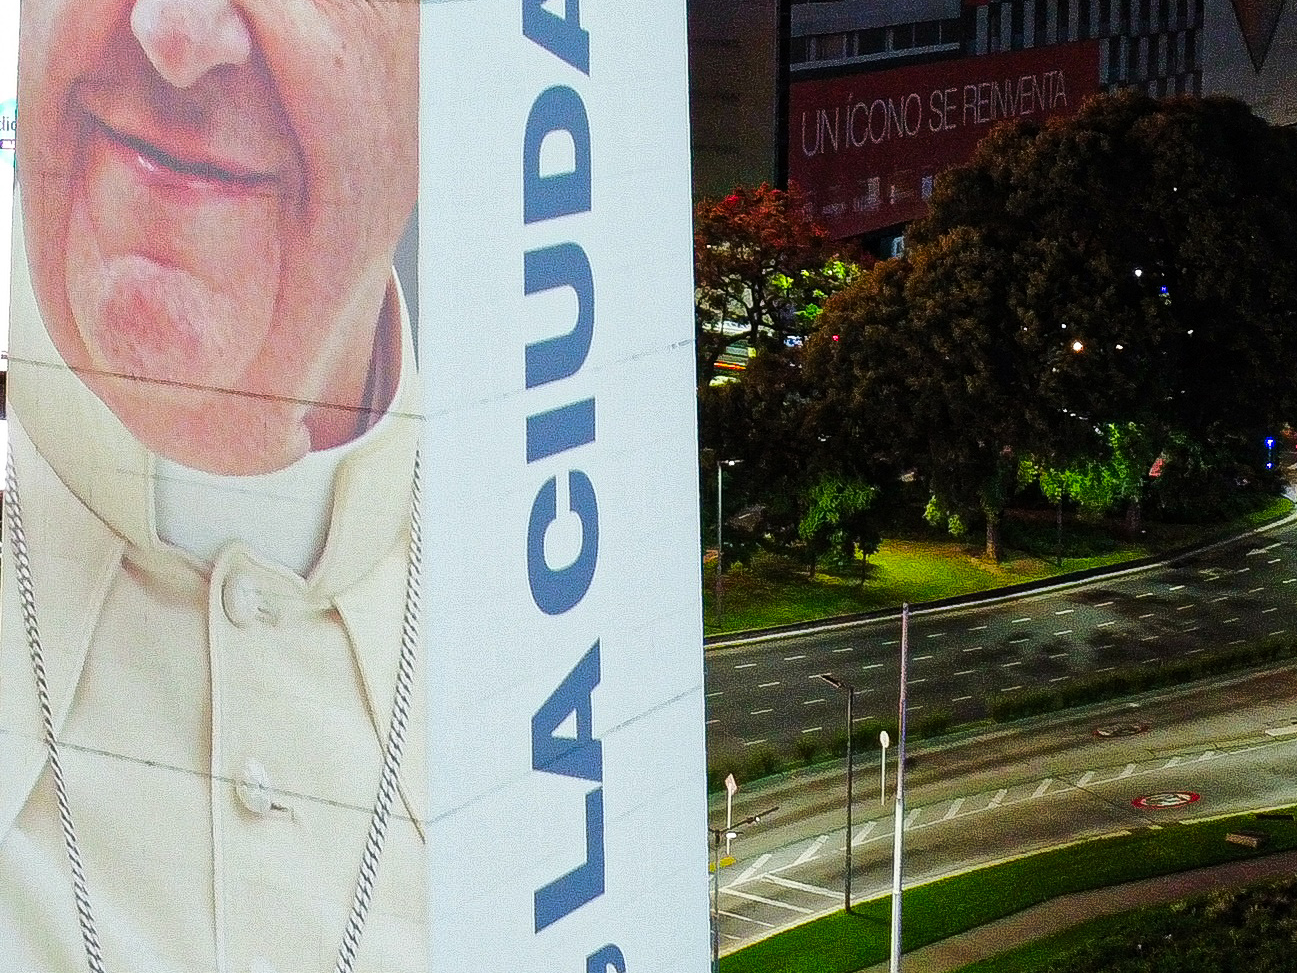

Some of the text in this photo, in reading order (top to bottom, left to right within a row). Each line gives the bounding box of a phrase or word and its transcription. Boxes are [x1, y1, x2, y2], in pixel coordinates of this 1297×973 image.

[802, 109, 840, 157] UN
[929, 87, 958, 133] SE
[963, 69, 1069, 127] REINVENTA
[533, 638, 605, 933] LA
